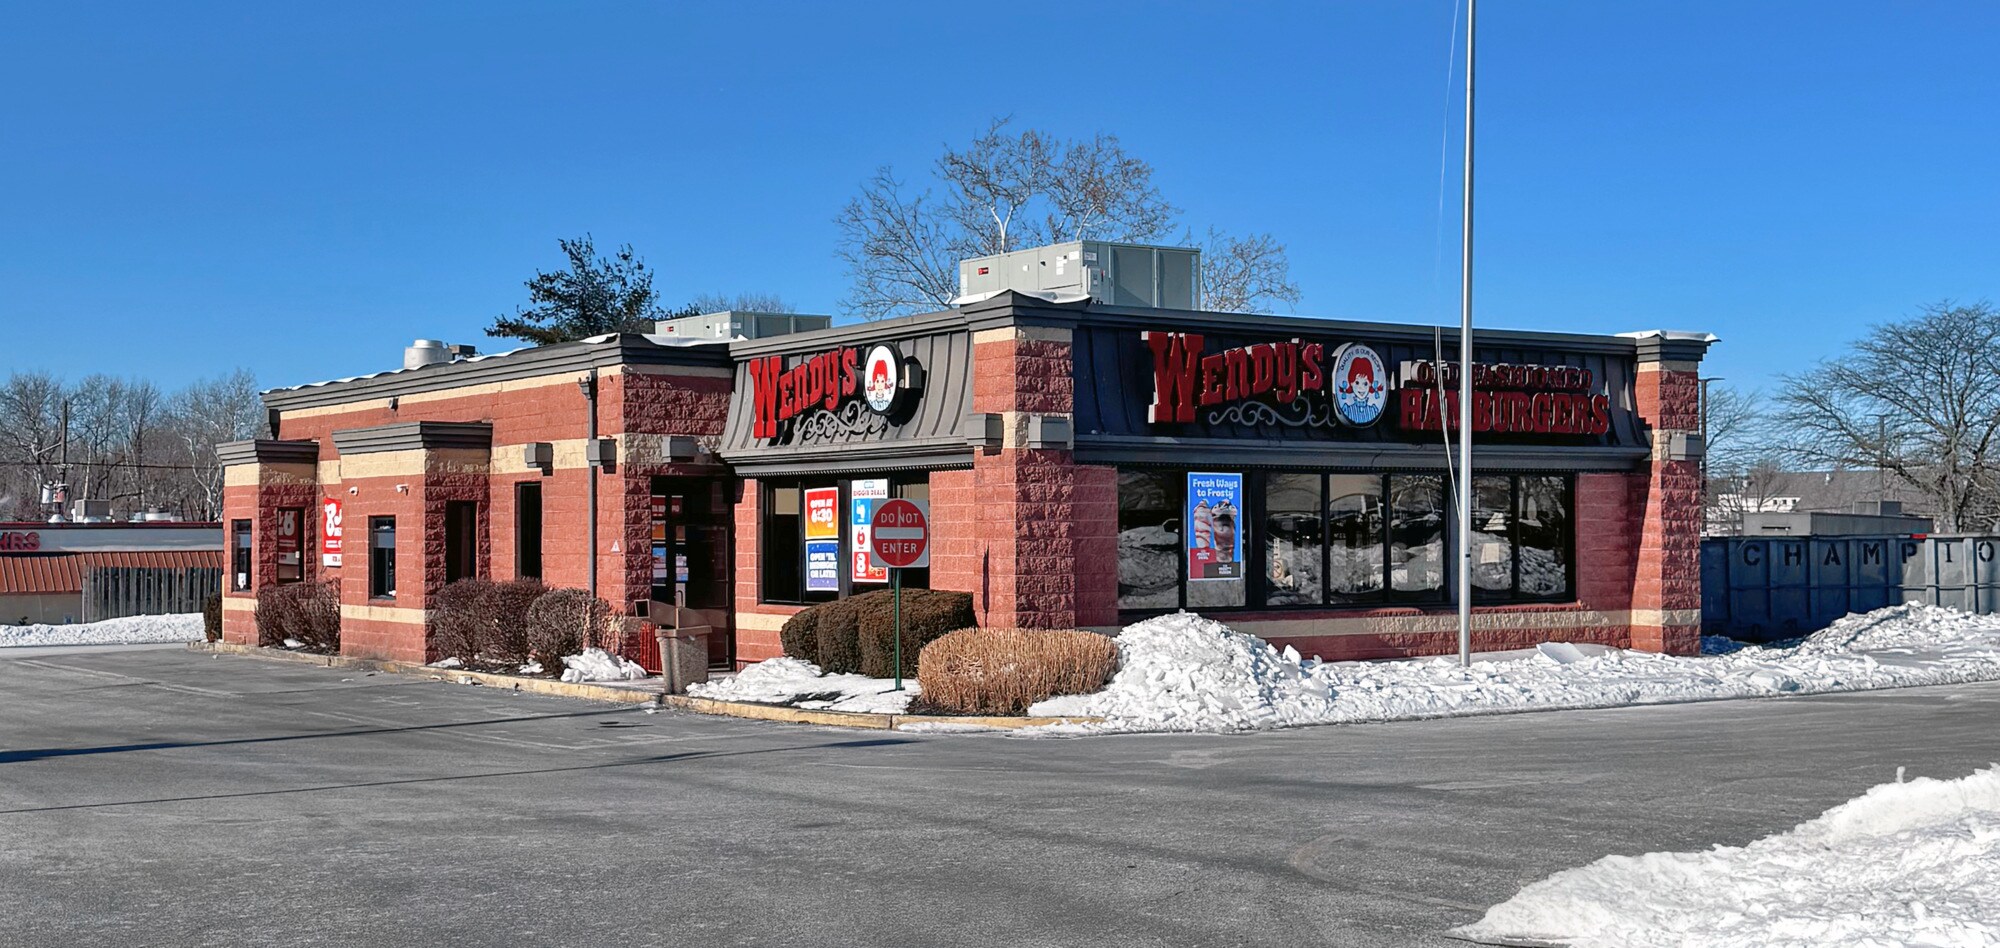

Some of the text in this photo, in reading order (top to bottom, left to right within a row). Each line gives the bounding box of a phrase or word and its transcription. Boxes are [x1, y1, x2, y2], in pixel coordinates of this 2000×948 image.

[1471, 364, 1594, 391] FASHIONED
[1193, 479, 1238, 490] Fresh Ways
[1197, 489, 1234, 500] to Frosty
[810, 498, 833, 508] OPEN AT
[811, 508, 833, 523] 6:30
[881, 513, 919, 523] DO NOT
[882, 543, 917, 554] ENTER
[810, 552, 825, 561] OPEN
[810, 570, 836, 579] OR LATER
